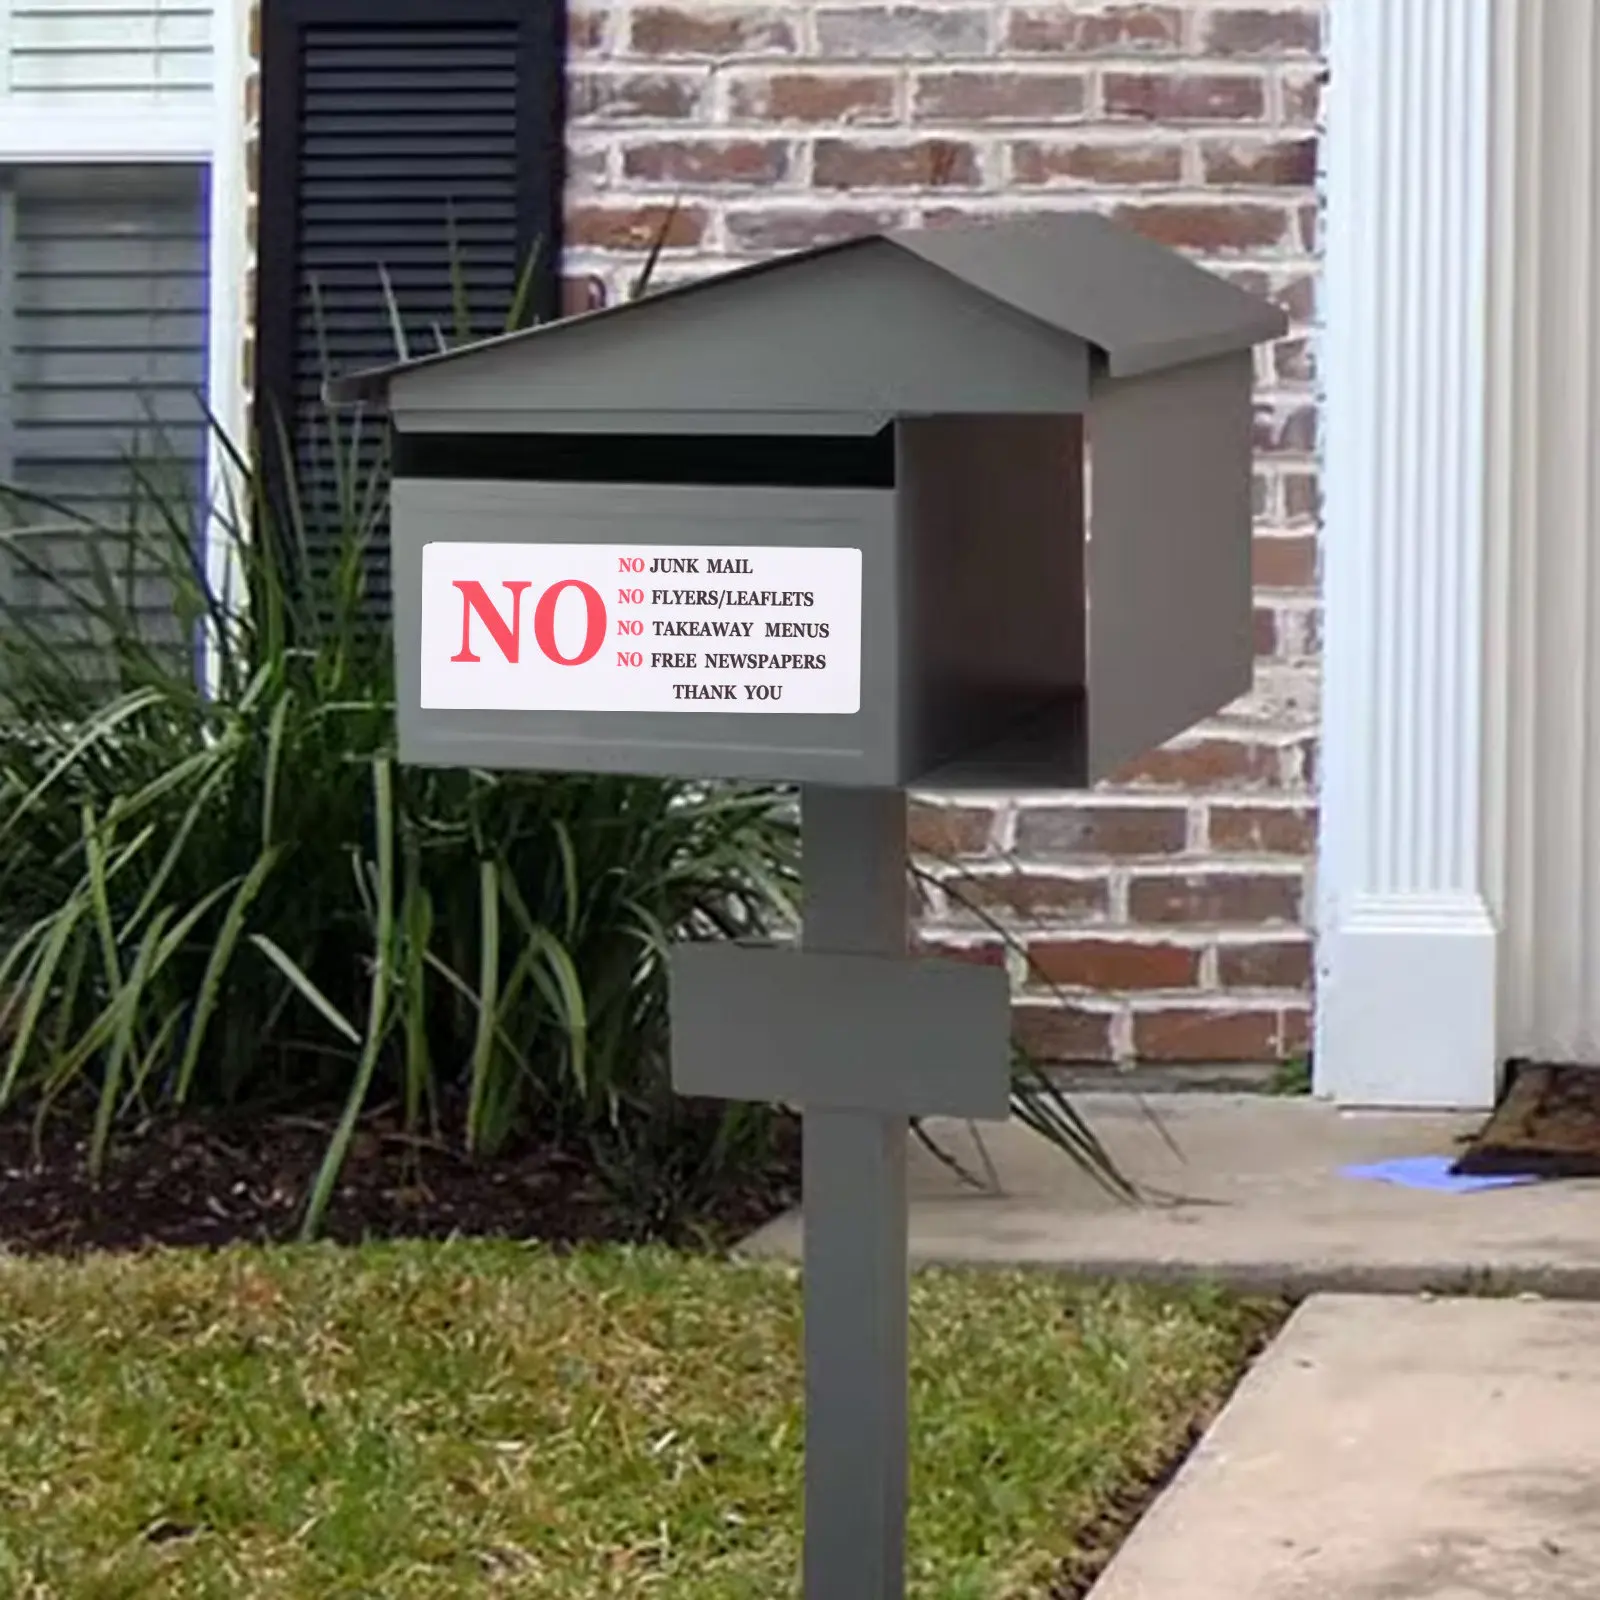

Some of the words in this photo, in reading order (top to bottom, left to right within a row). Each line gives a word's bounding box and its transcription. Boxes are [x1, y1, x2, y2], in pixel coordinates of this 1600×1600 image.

[618, 557, 646, 573] NO
[649, 557, 700, 574] JUNK
[706, 558, 754, 574] MAIL
[618, 588, 645, 605] NO
[651, 589, 814, 609] FLYERS/LEAFLETS
[450, 579, 608, 667] NO
[617, 620, 644, 636] NO
[652, 620, 755, 637] TAKEAWAY
[764, 622, 830, 639] MENUS
[616, 651, 643, 668] NO
[650, 652, 697, 669] FREE
[704, 653, 827, 670] NEWSPAPERS
[672, 684, 738, 700] THANK
[743, 684, 783, 701] YOU
